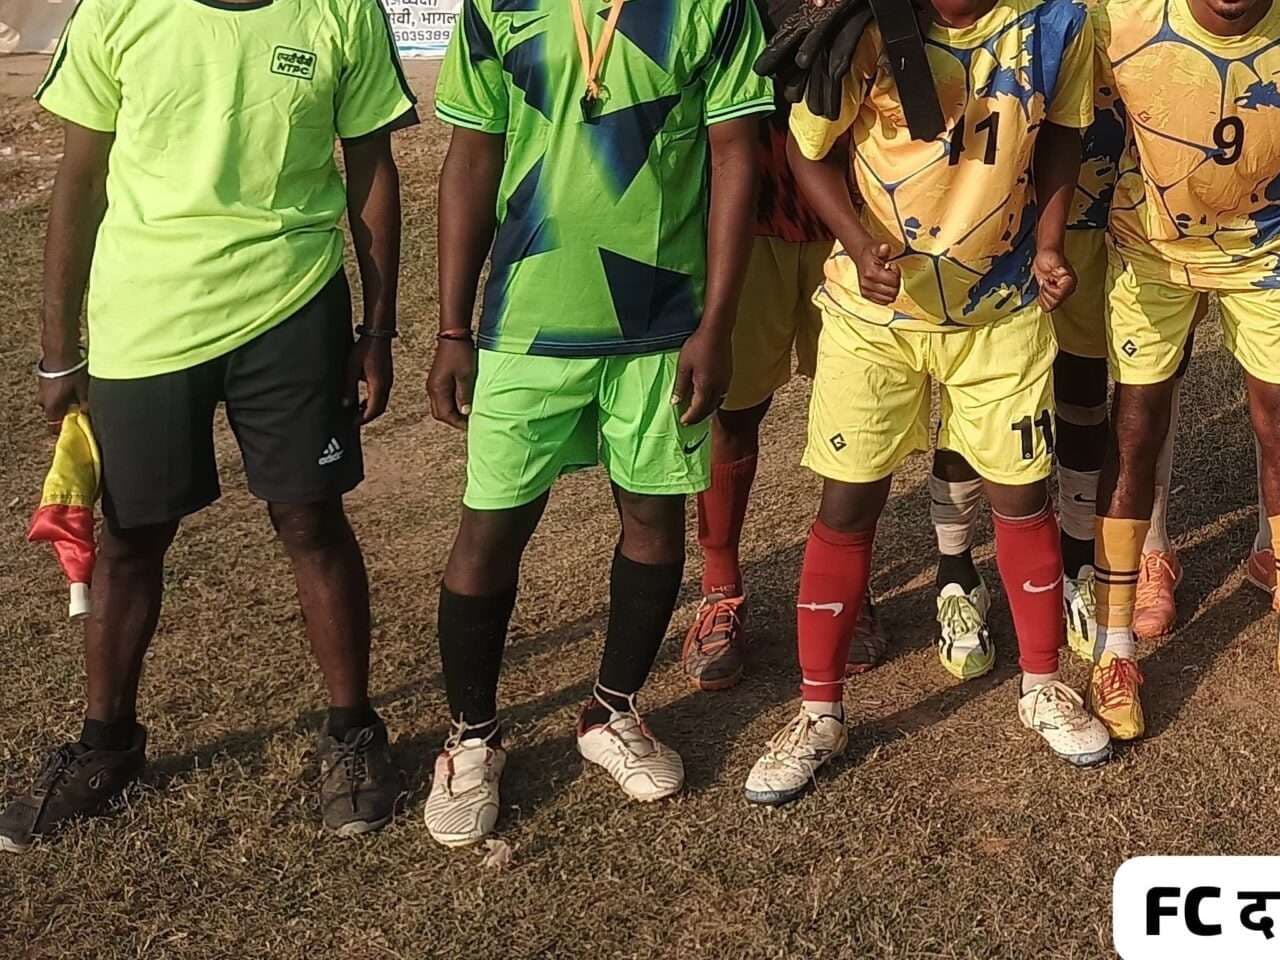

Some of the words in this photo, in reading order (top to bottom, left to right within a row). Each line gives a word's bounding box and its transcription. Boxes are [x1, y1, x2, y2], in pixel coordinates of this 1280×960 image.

[277, 62, 310, 75] NTPC
[948, 111, 1000, 166] 11
[1213, 115, 1245, 165] 9
[1011, 408, 1054, 460] 11
